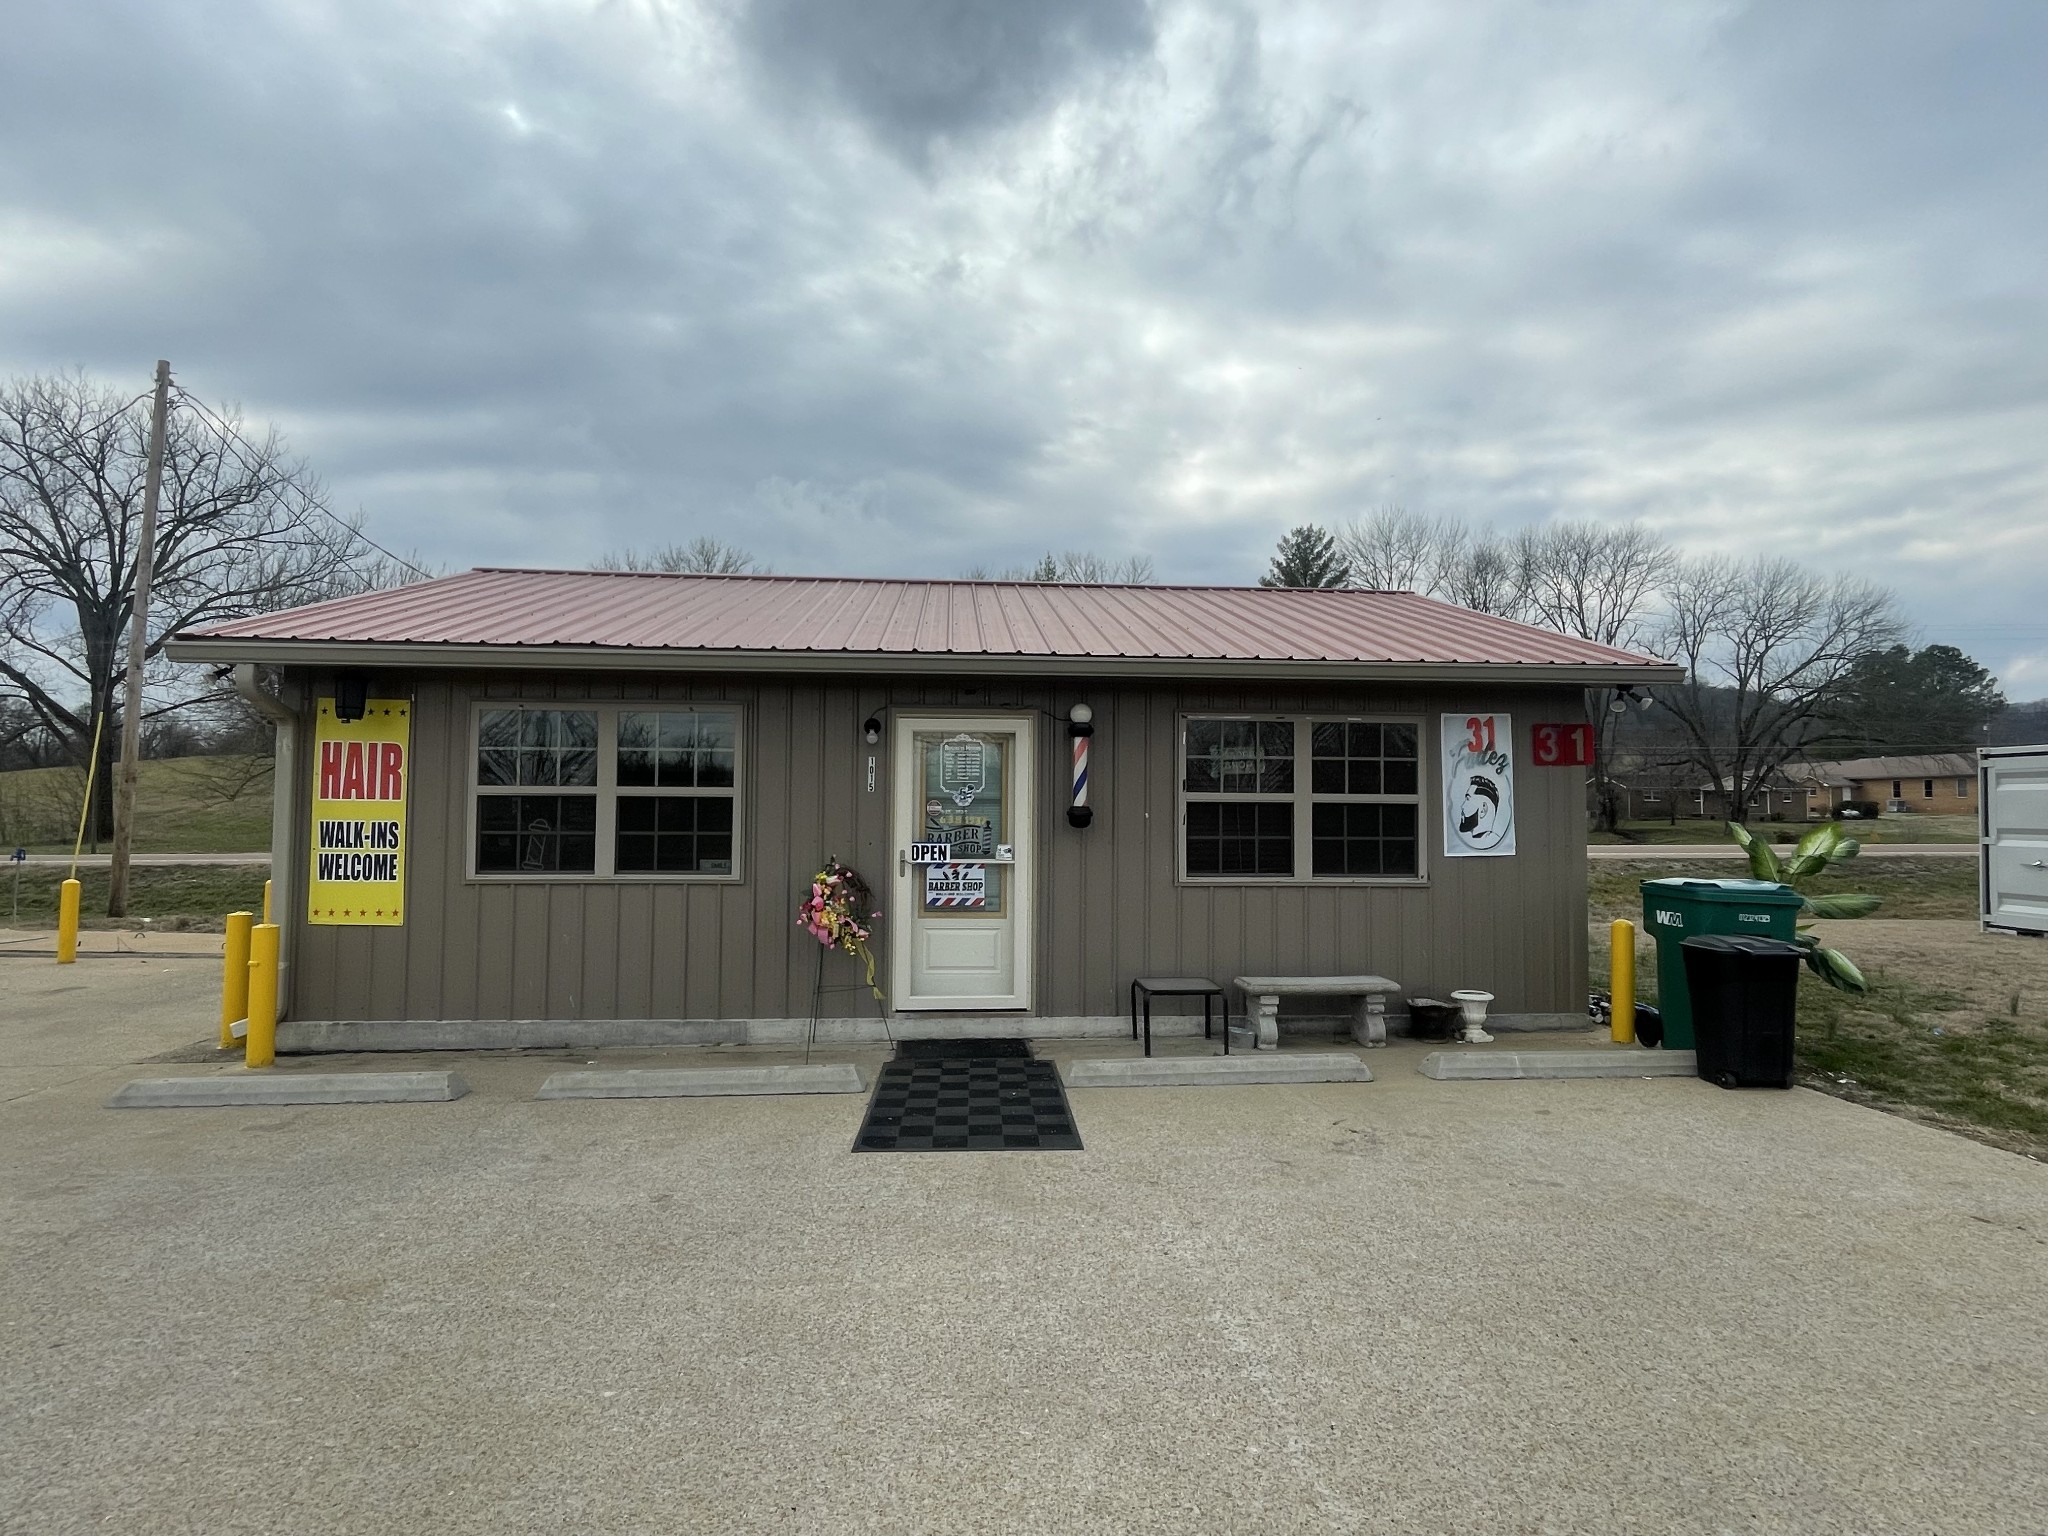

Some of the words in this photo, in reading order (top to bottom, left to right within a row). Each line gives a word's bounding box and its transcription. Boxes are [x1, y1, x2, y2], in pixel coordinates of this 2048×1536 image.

[1466, 716, 1495, 752] 31
[319, 741, 404, 800] HAIR
[318, 820, 399, 849] WALK-INS
[927, 827, 979, 843] BARBER
[911, 844, 948, 861] OPEN
[957, 842, 982, 854] SHOP
[318, 853, 398, 881] WELCOME
[928, 881, 960, 891] BARBER
[961, 881, 983, 891] SHOP
[1656, 909, 1683, 928] WM
